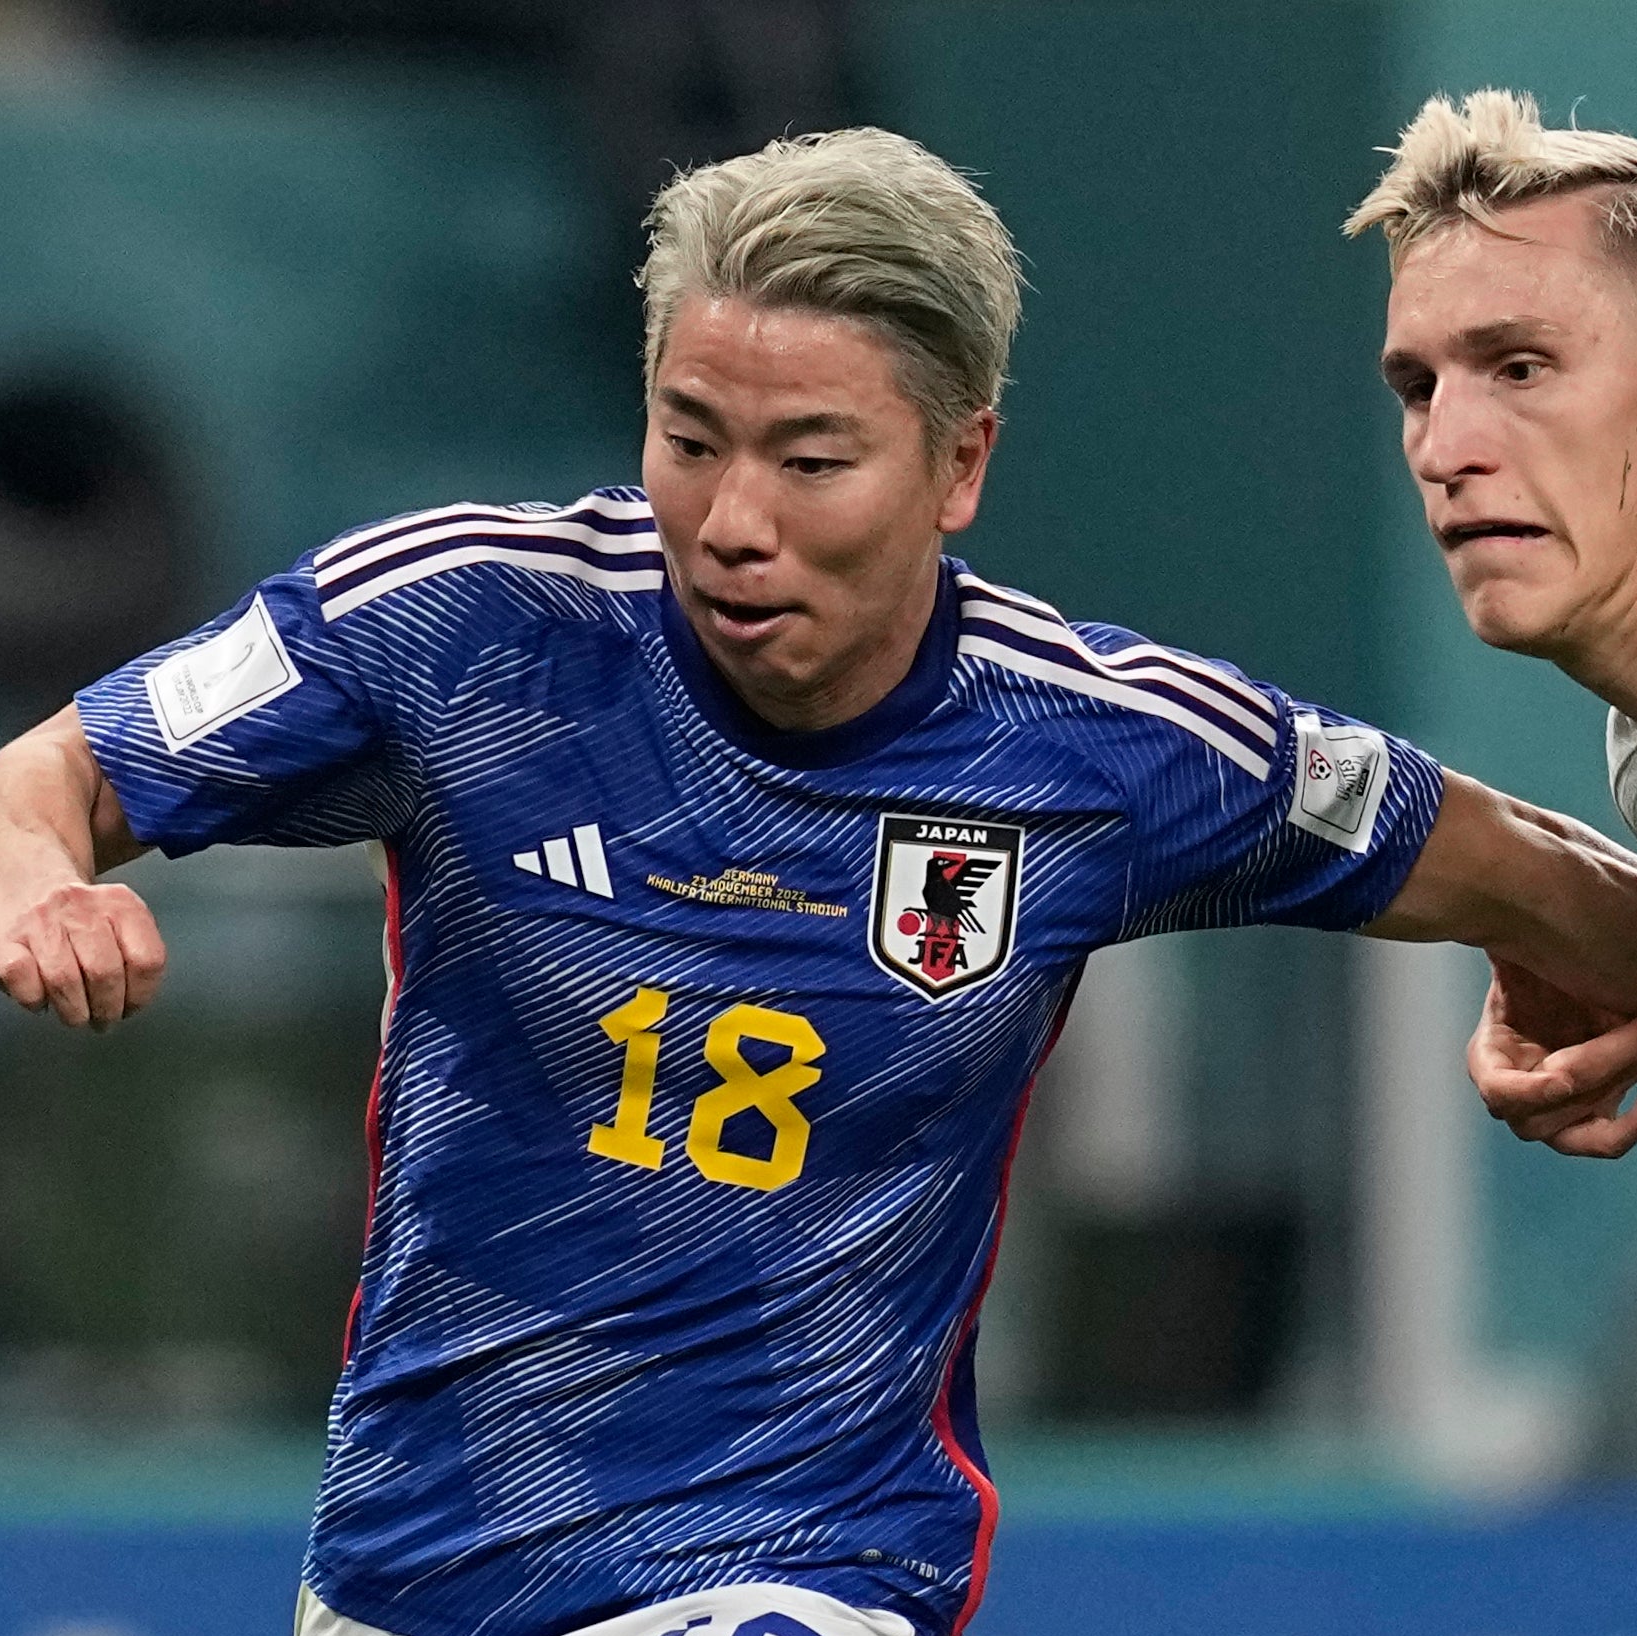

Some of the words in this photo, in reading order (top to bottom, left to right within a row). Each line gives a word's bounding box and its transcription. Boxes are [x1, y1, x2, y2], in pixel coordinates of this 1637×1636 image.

[915, 824, 988, 844] JAPAN
[690, 875, 707, 888] 23
[711, 880, 773, 898] NOVEMBER
[776, 887, 807, 902] 2022
[723, 868, 779, 887] GERMANY
[646, 873, 697, 899] KHALIFA
[699, 890, 793, 912] INTERNATIONAL
[795, 901, 849, 918] STADIUM
[907, 939, 969, 970] JFA
[586, 986, 827, 1193] 18
